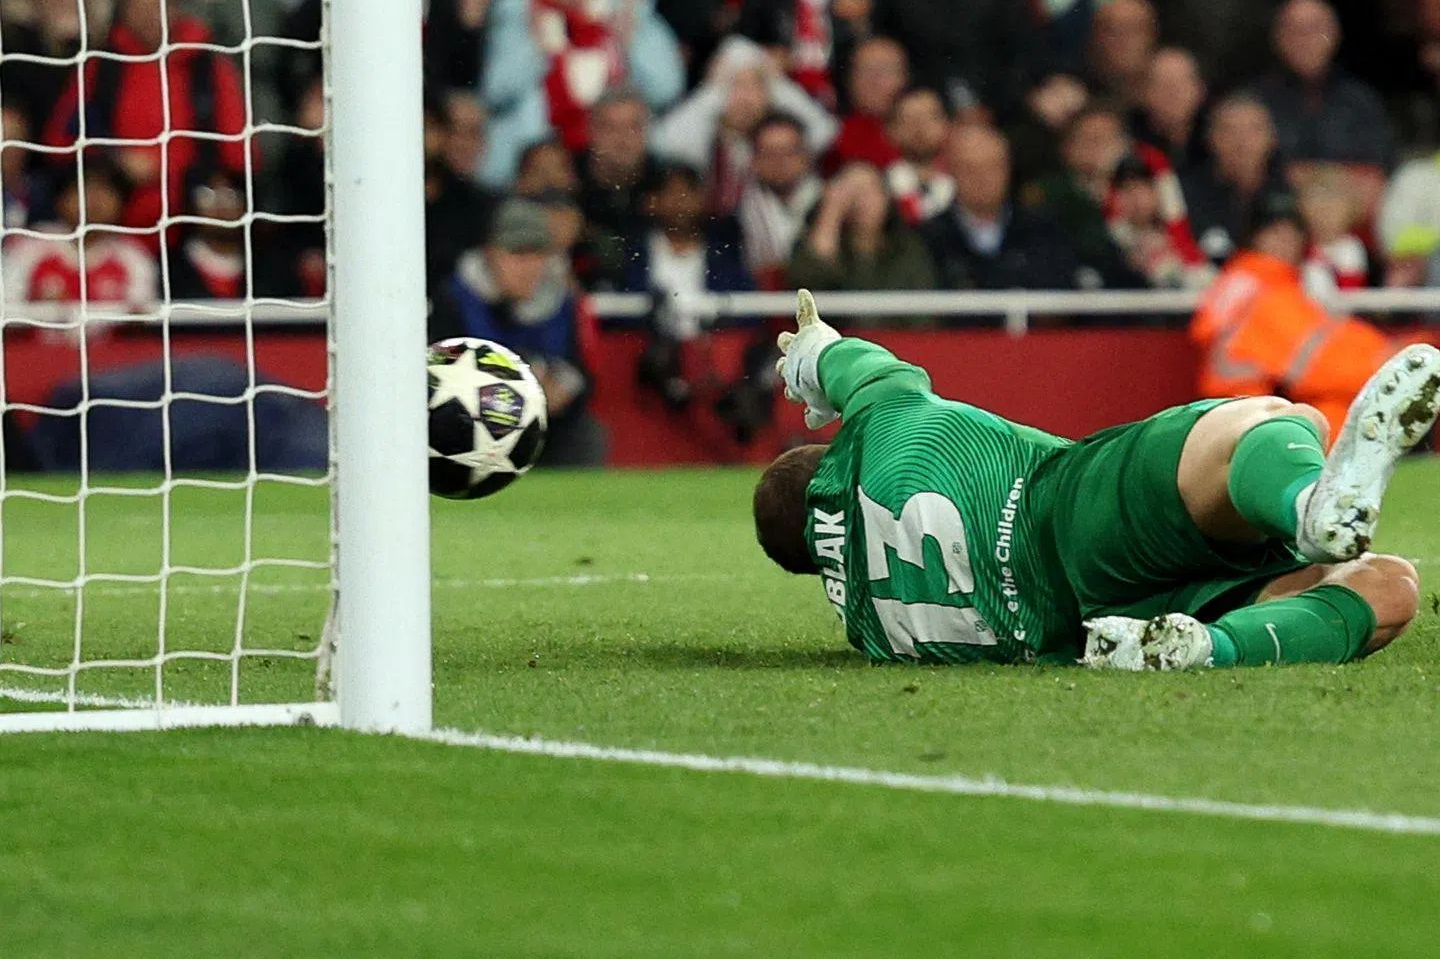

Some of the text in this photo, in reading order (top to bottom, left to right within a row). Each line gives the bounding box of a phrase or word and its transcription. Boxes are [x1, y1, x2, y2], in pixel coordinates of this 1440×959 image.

[814, 507, 846, 624] BLAK
[996, 477, 1024, 563] Children
[857, 484, 998, 659] 13
[1001, 567, 1018, 598] the
